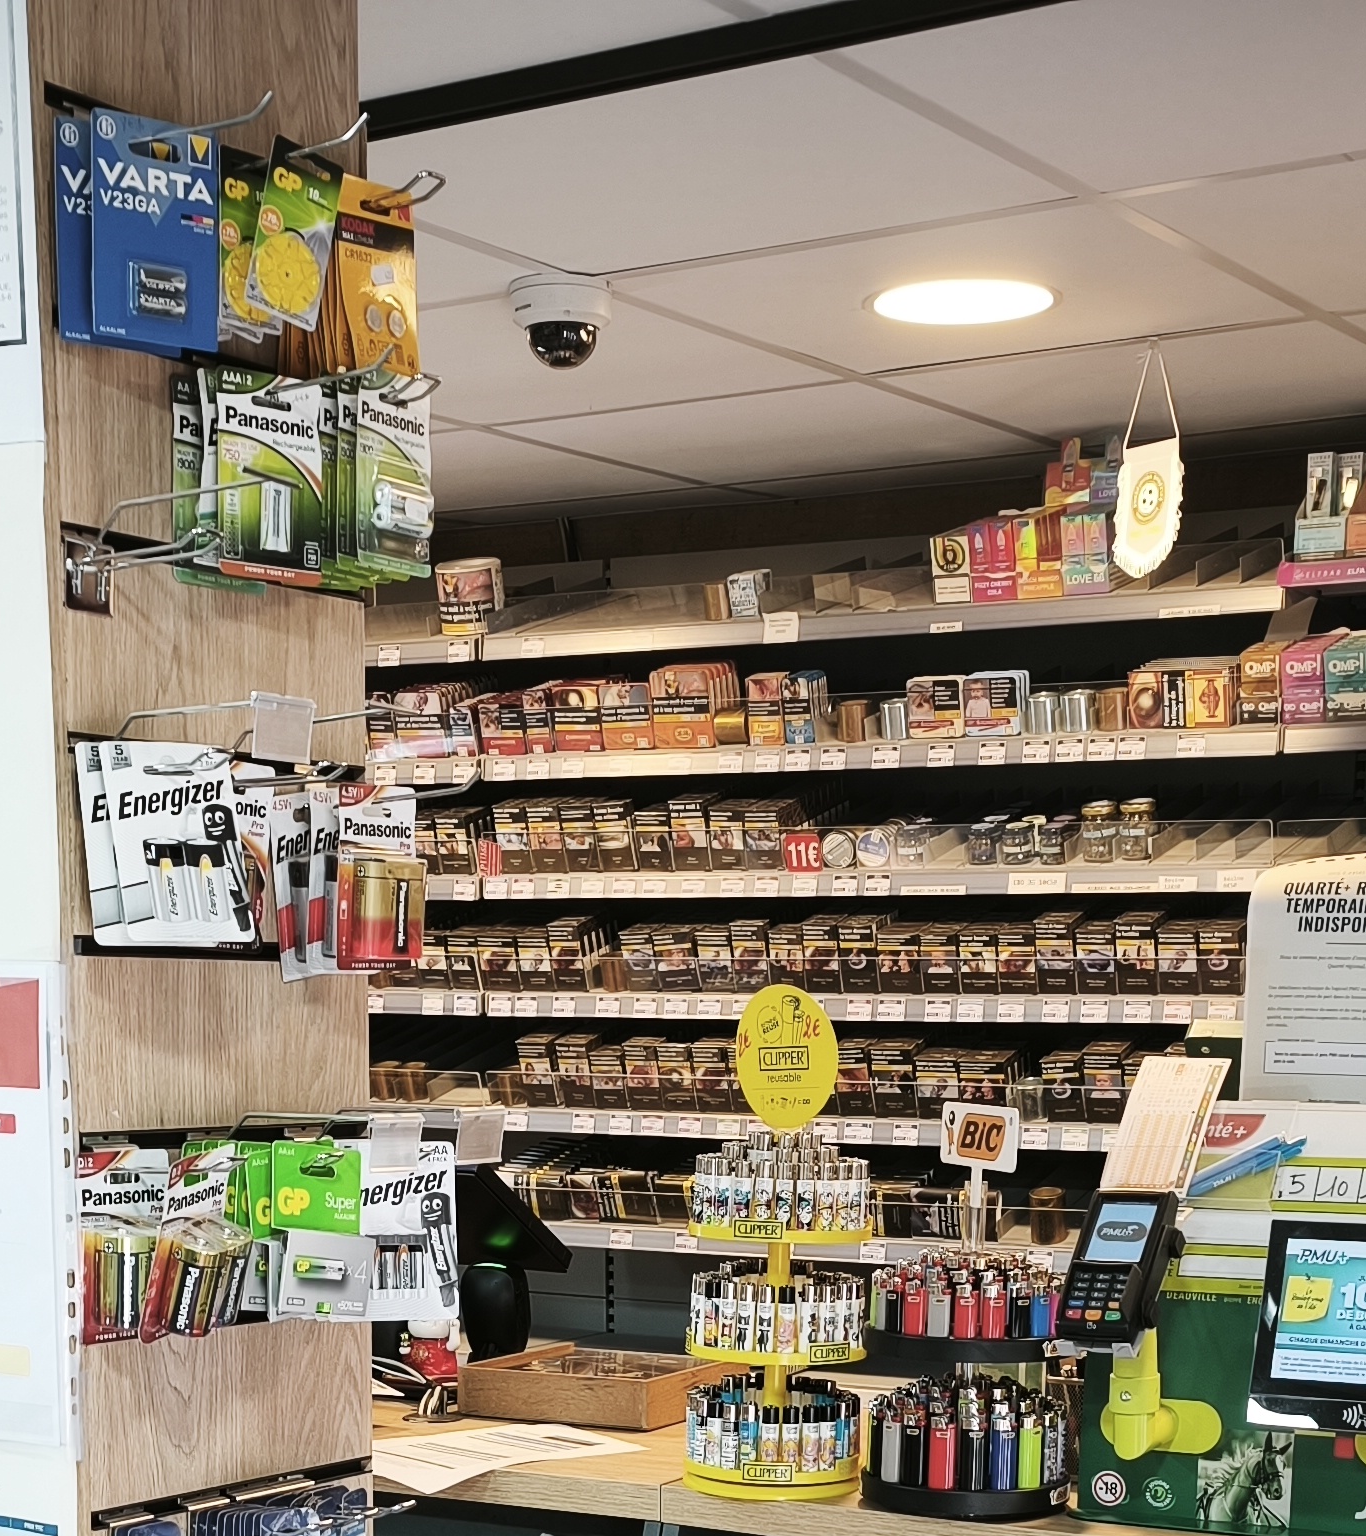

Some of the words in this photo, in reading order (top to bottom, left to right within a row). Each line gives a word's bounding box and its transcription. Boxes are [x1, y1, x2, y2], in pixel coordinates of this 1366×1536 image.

[98, 156, 214, 205] VARTA
[273, 167, 302, 192] GP
[99, 188, 161, 216] V23GA
[340, 217, 375, 236] KODAK
[225, 407, 314, 439] Panasonic
[1066, 573, 1084, 585] LOVE
[118, 778, 224, 820] Energizer
[344, 818, 412, 839] Panasonic
[785, 837, 819, 868] 11€
[1283, 878, 1351, 898] QUARTÉ+
[763, 1050, 804, 1066] CLIPPER
[767, 1073, 802, 1083] reusable
[360, 1170, 447, 1207] nergizer
[277, 1187, 310, 1216] GP
[324, 1193, 356, 1211] Super
[736, 1220, 782, 1238] CLIPPER
